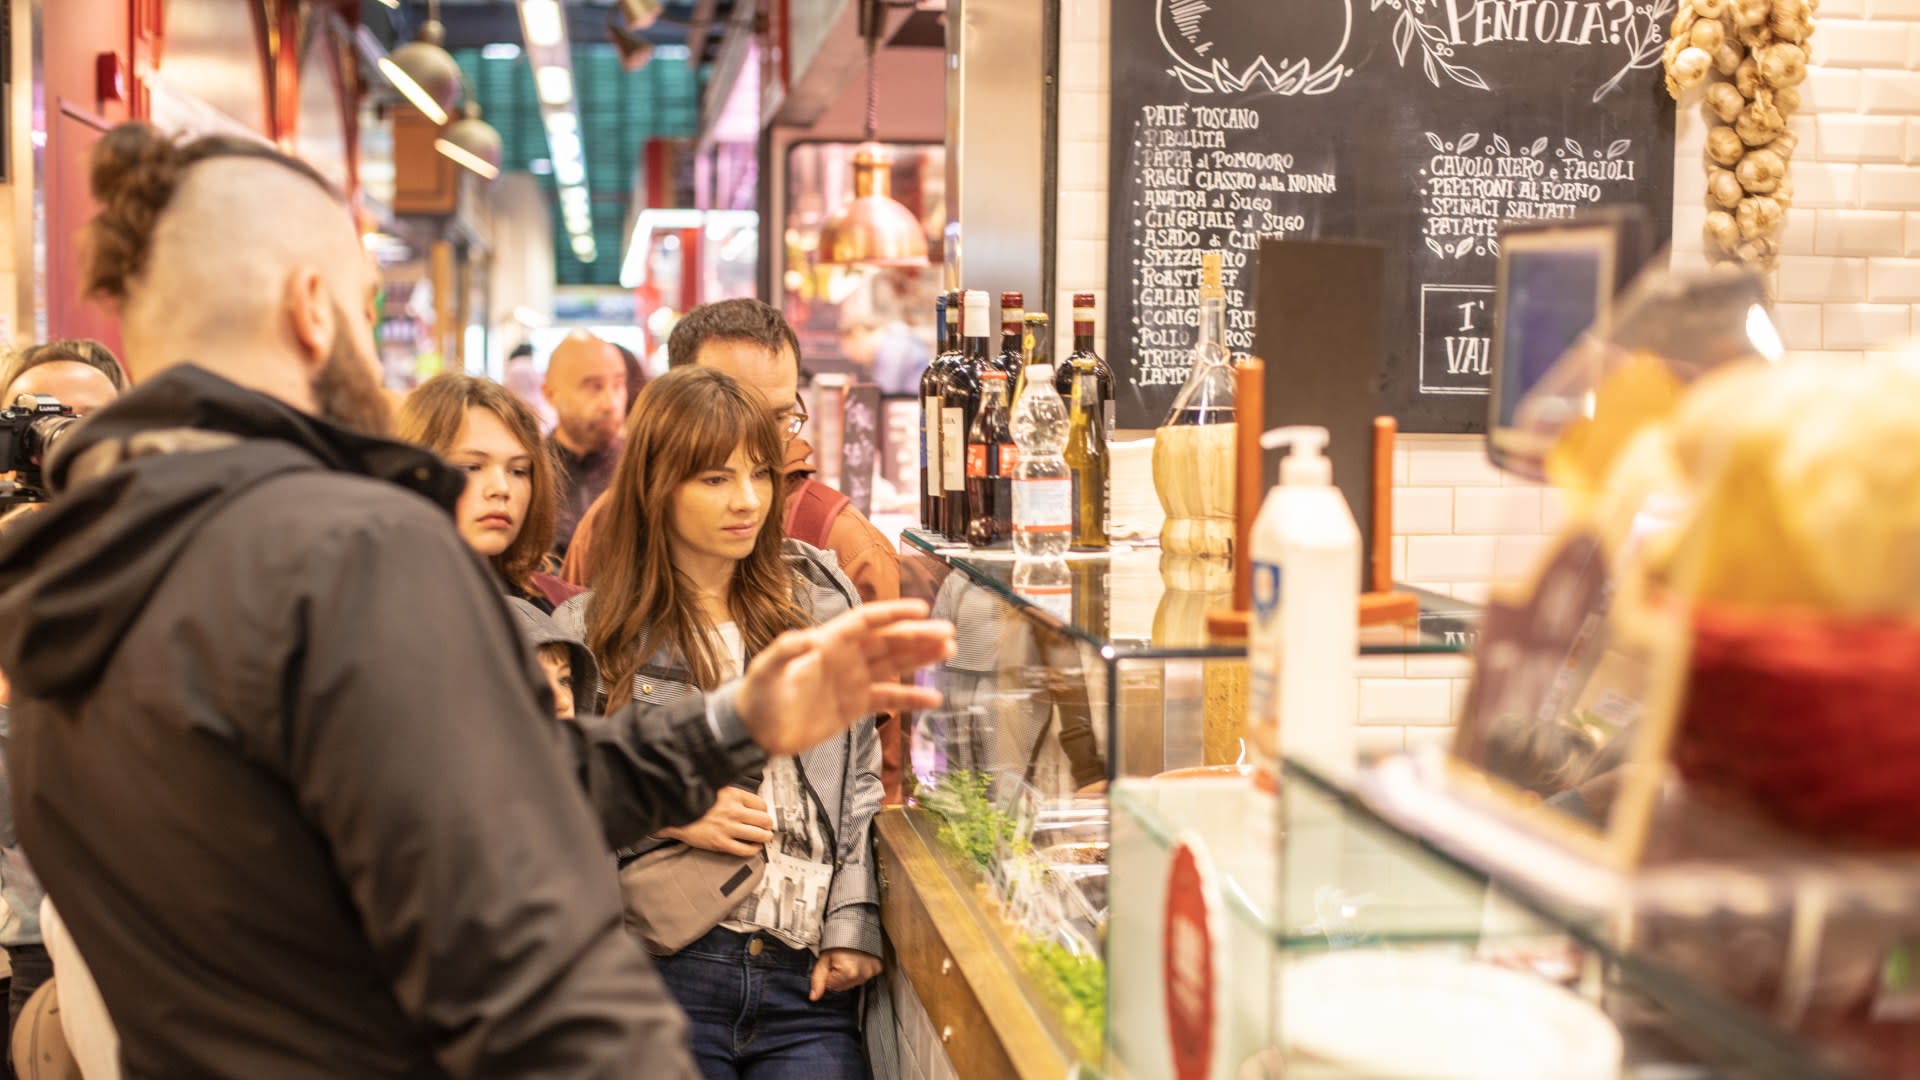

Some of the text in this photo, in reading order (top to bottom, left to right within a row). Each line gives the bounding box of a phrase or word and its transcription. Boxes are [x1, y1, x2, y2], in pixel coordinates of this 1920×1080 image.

[1447, 0, 1633, 46] PENTOLA?
[1192, 106, 1259, 129] TOSCANO
[1211, 151, 1294, 172] POMODORO
[1431, 155, 1492, 177] CAVOLO
[1497, 157, 1544, 181] NERO
[1561, 158, 1635, 181] FAGIOLI
[1195, 171, 1256, 191] CLASSICO
[1287, 173, 1337, 193] NONNA
[1428, 178, 1601, 202] PEPERONI AL FORNO
[1144, 190, 1208, 210] ANATRA
[1430, 199, 1577, 219] SPINACI SALTATI
[1144, 210, 1236, 230] CINGHIALE
[1427, 217, 1498, 237] PATATE
[1142, 228, 1200, 249] ASADO
[1138, 327, 1190, 347] POLLO
[1444, 336, 1493, 375] VAL
